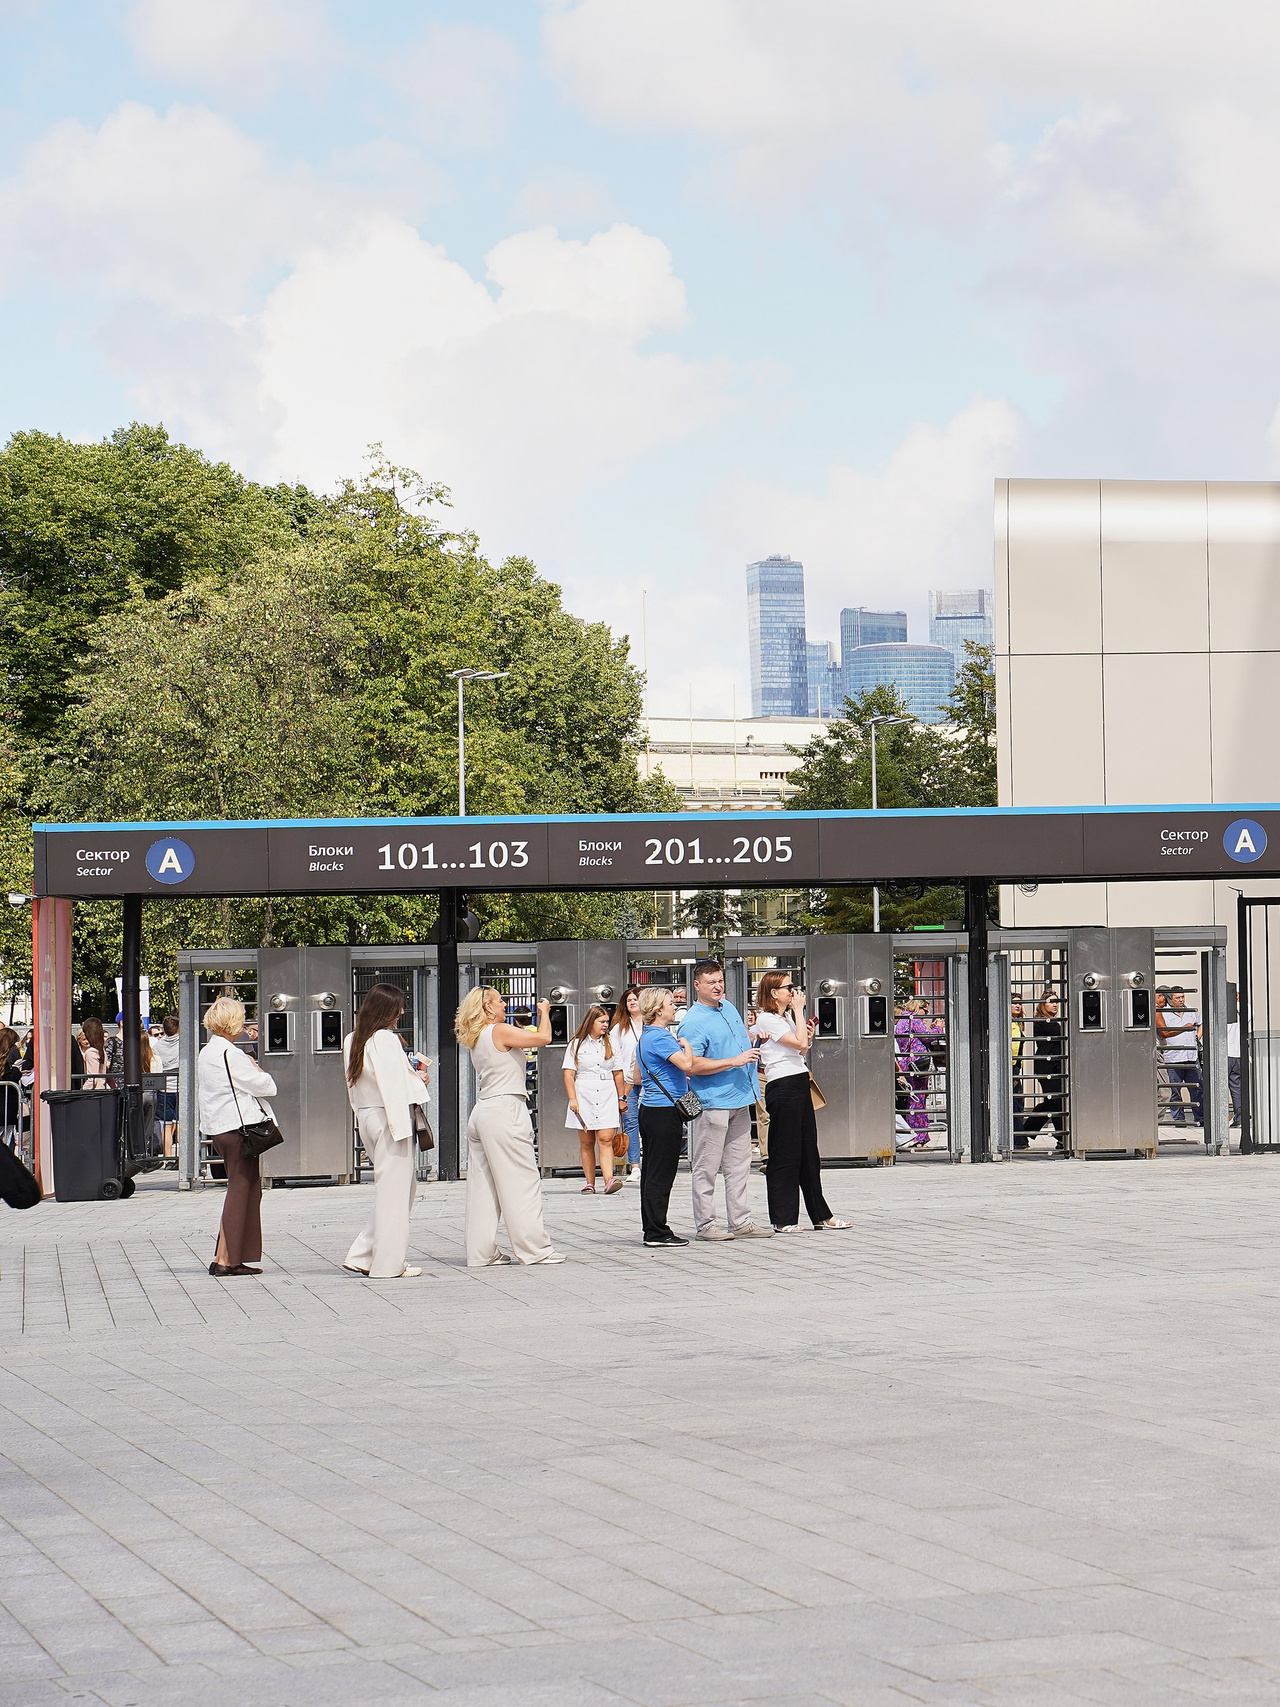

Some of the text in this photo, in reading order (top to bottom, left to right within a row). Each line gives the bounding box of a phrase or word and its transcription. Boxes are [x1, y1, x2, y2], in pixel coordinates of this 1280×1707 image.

[1160, 829, 1209, 843] Сектор
[1234, 828, 1257, 853] A
[308, 845, 354, 857] Блоки
[578, 840, 622, 852] Блоки
[644, 836, 793, 865] 201...205
[1160, 846, 1194, 856] Sector
[76, 849, 130, 863] Сектор
[157, 847, 183, 874] A
[378, 841, 529, 870] 101...103
[578, 855, 613, 866] Blocks
[76, 866, 114, 877] Sector
[308, 861, 344, 872] Blocks
